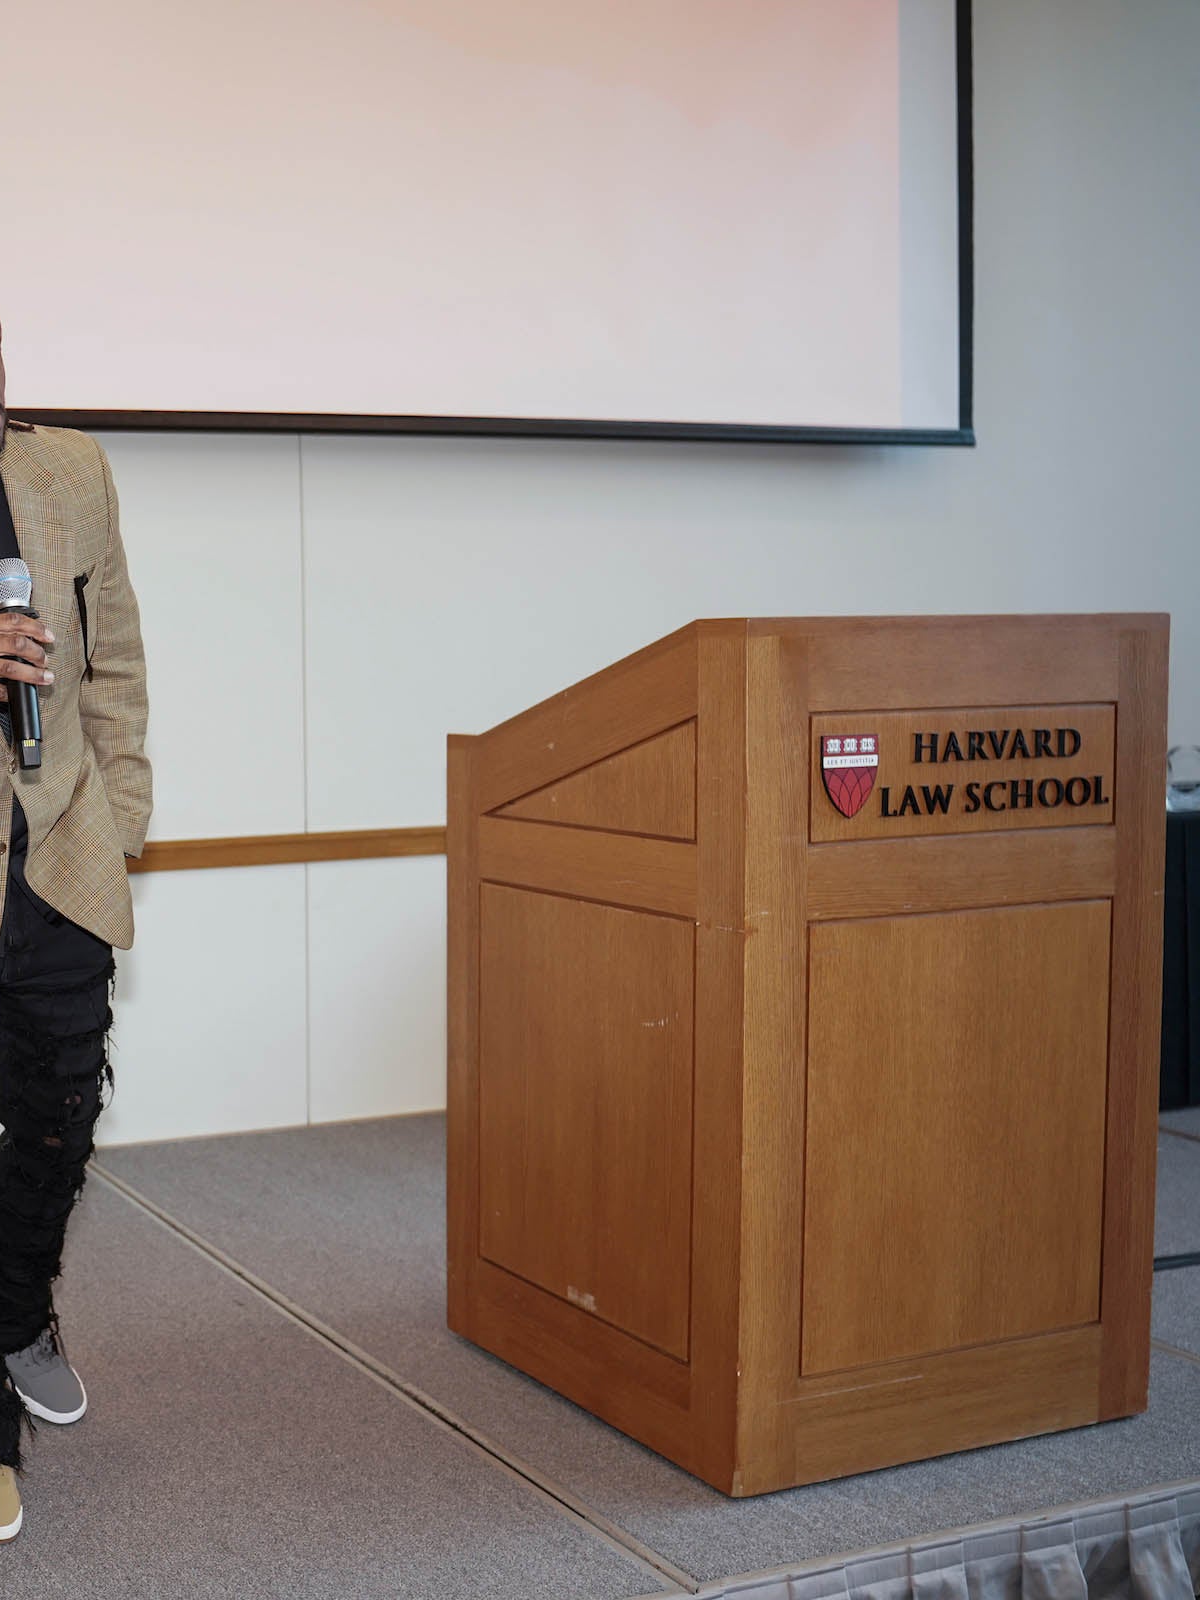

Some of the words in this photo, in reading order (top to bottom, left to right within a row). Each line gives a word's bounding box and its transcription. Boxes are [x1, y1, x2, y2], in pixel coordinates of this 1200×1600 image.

[913, 728, 1082, 764] HARVARD
[879, 783, 955, 818] LAW
[964, 775, 1110, 814] SCHOOL
